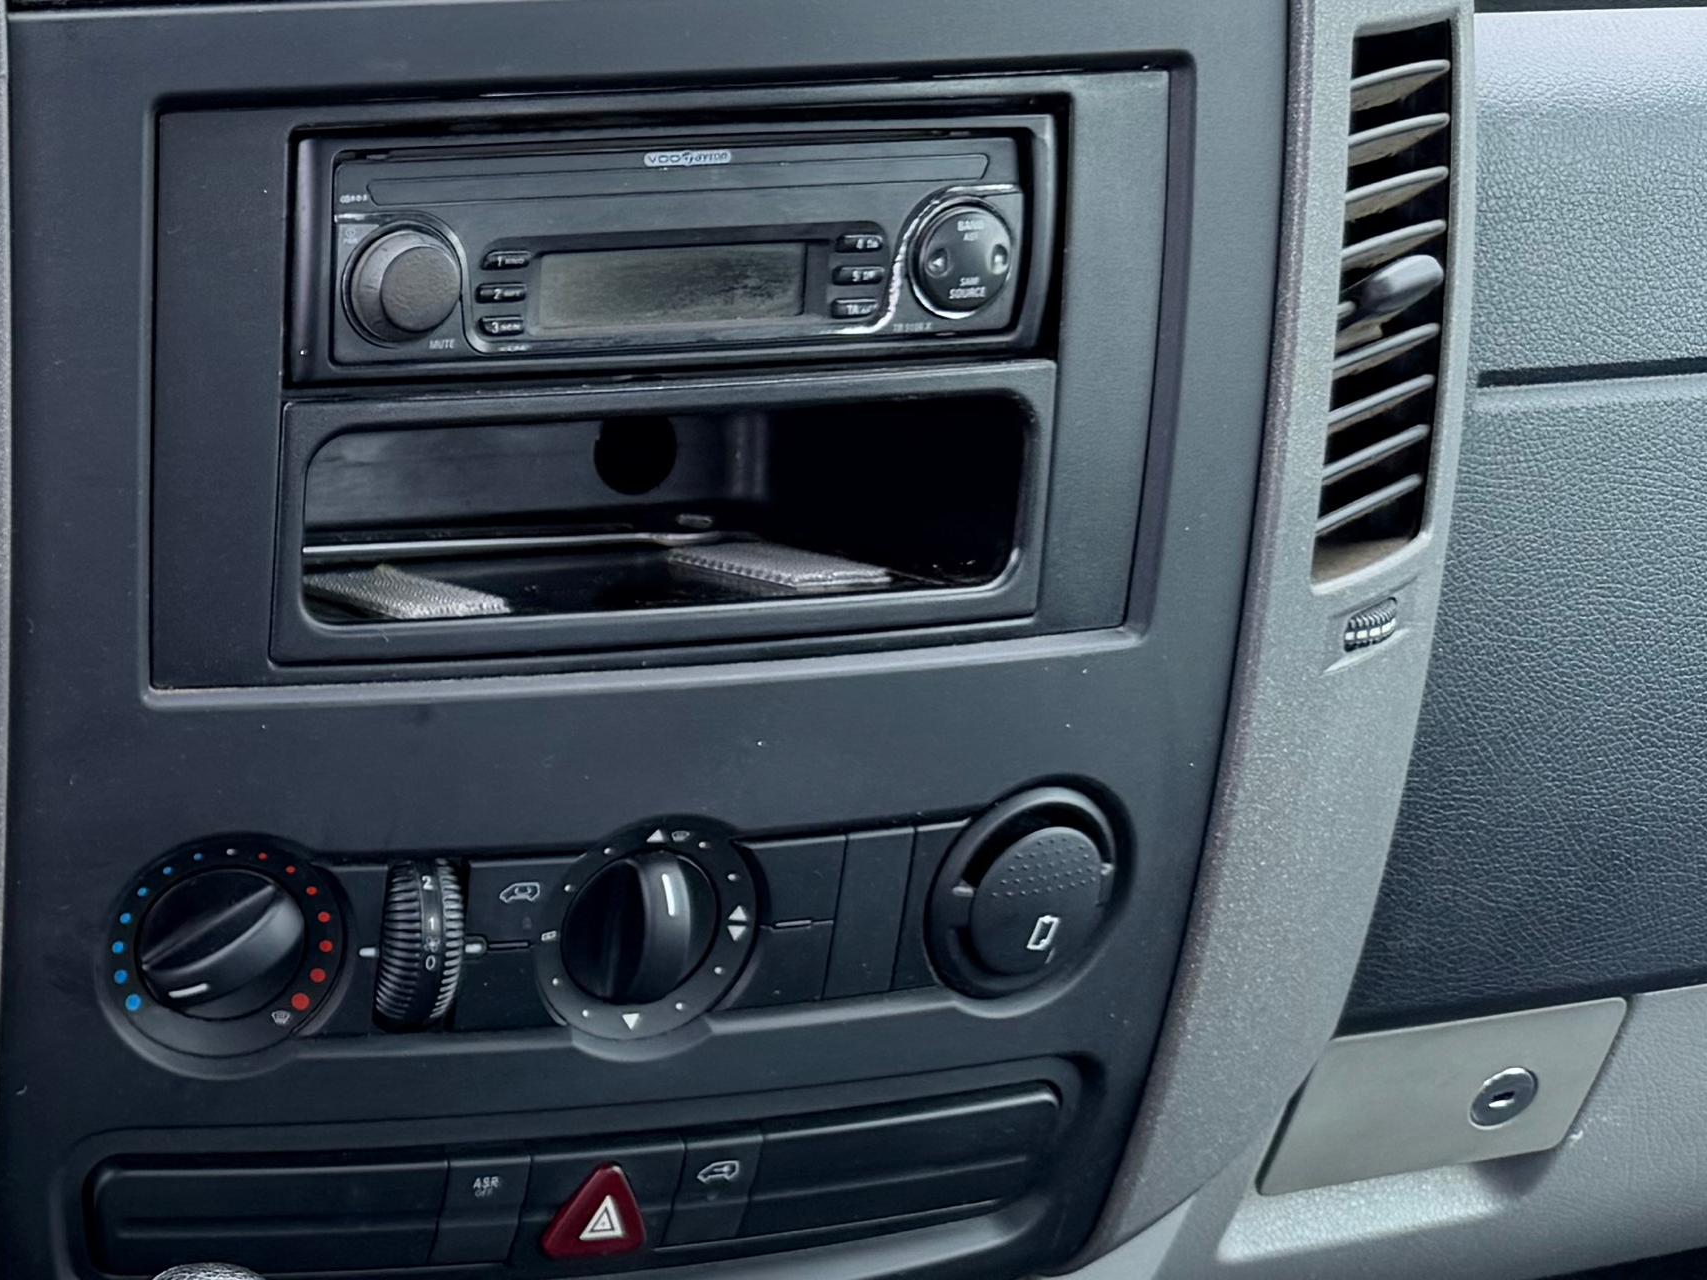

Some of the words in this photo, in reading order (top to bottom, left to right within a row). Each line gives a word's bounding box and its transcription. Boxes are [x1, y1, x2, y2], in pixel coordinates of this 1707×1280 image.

[421, 874, 434, 891] 2
[424, 954, 436, 971] 0
[472, 1176, 499, 1190] ASR
